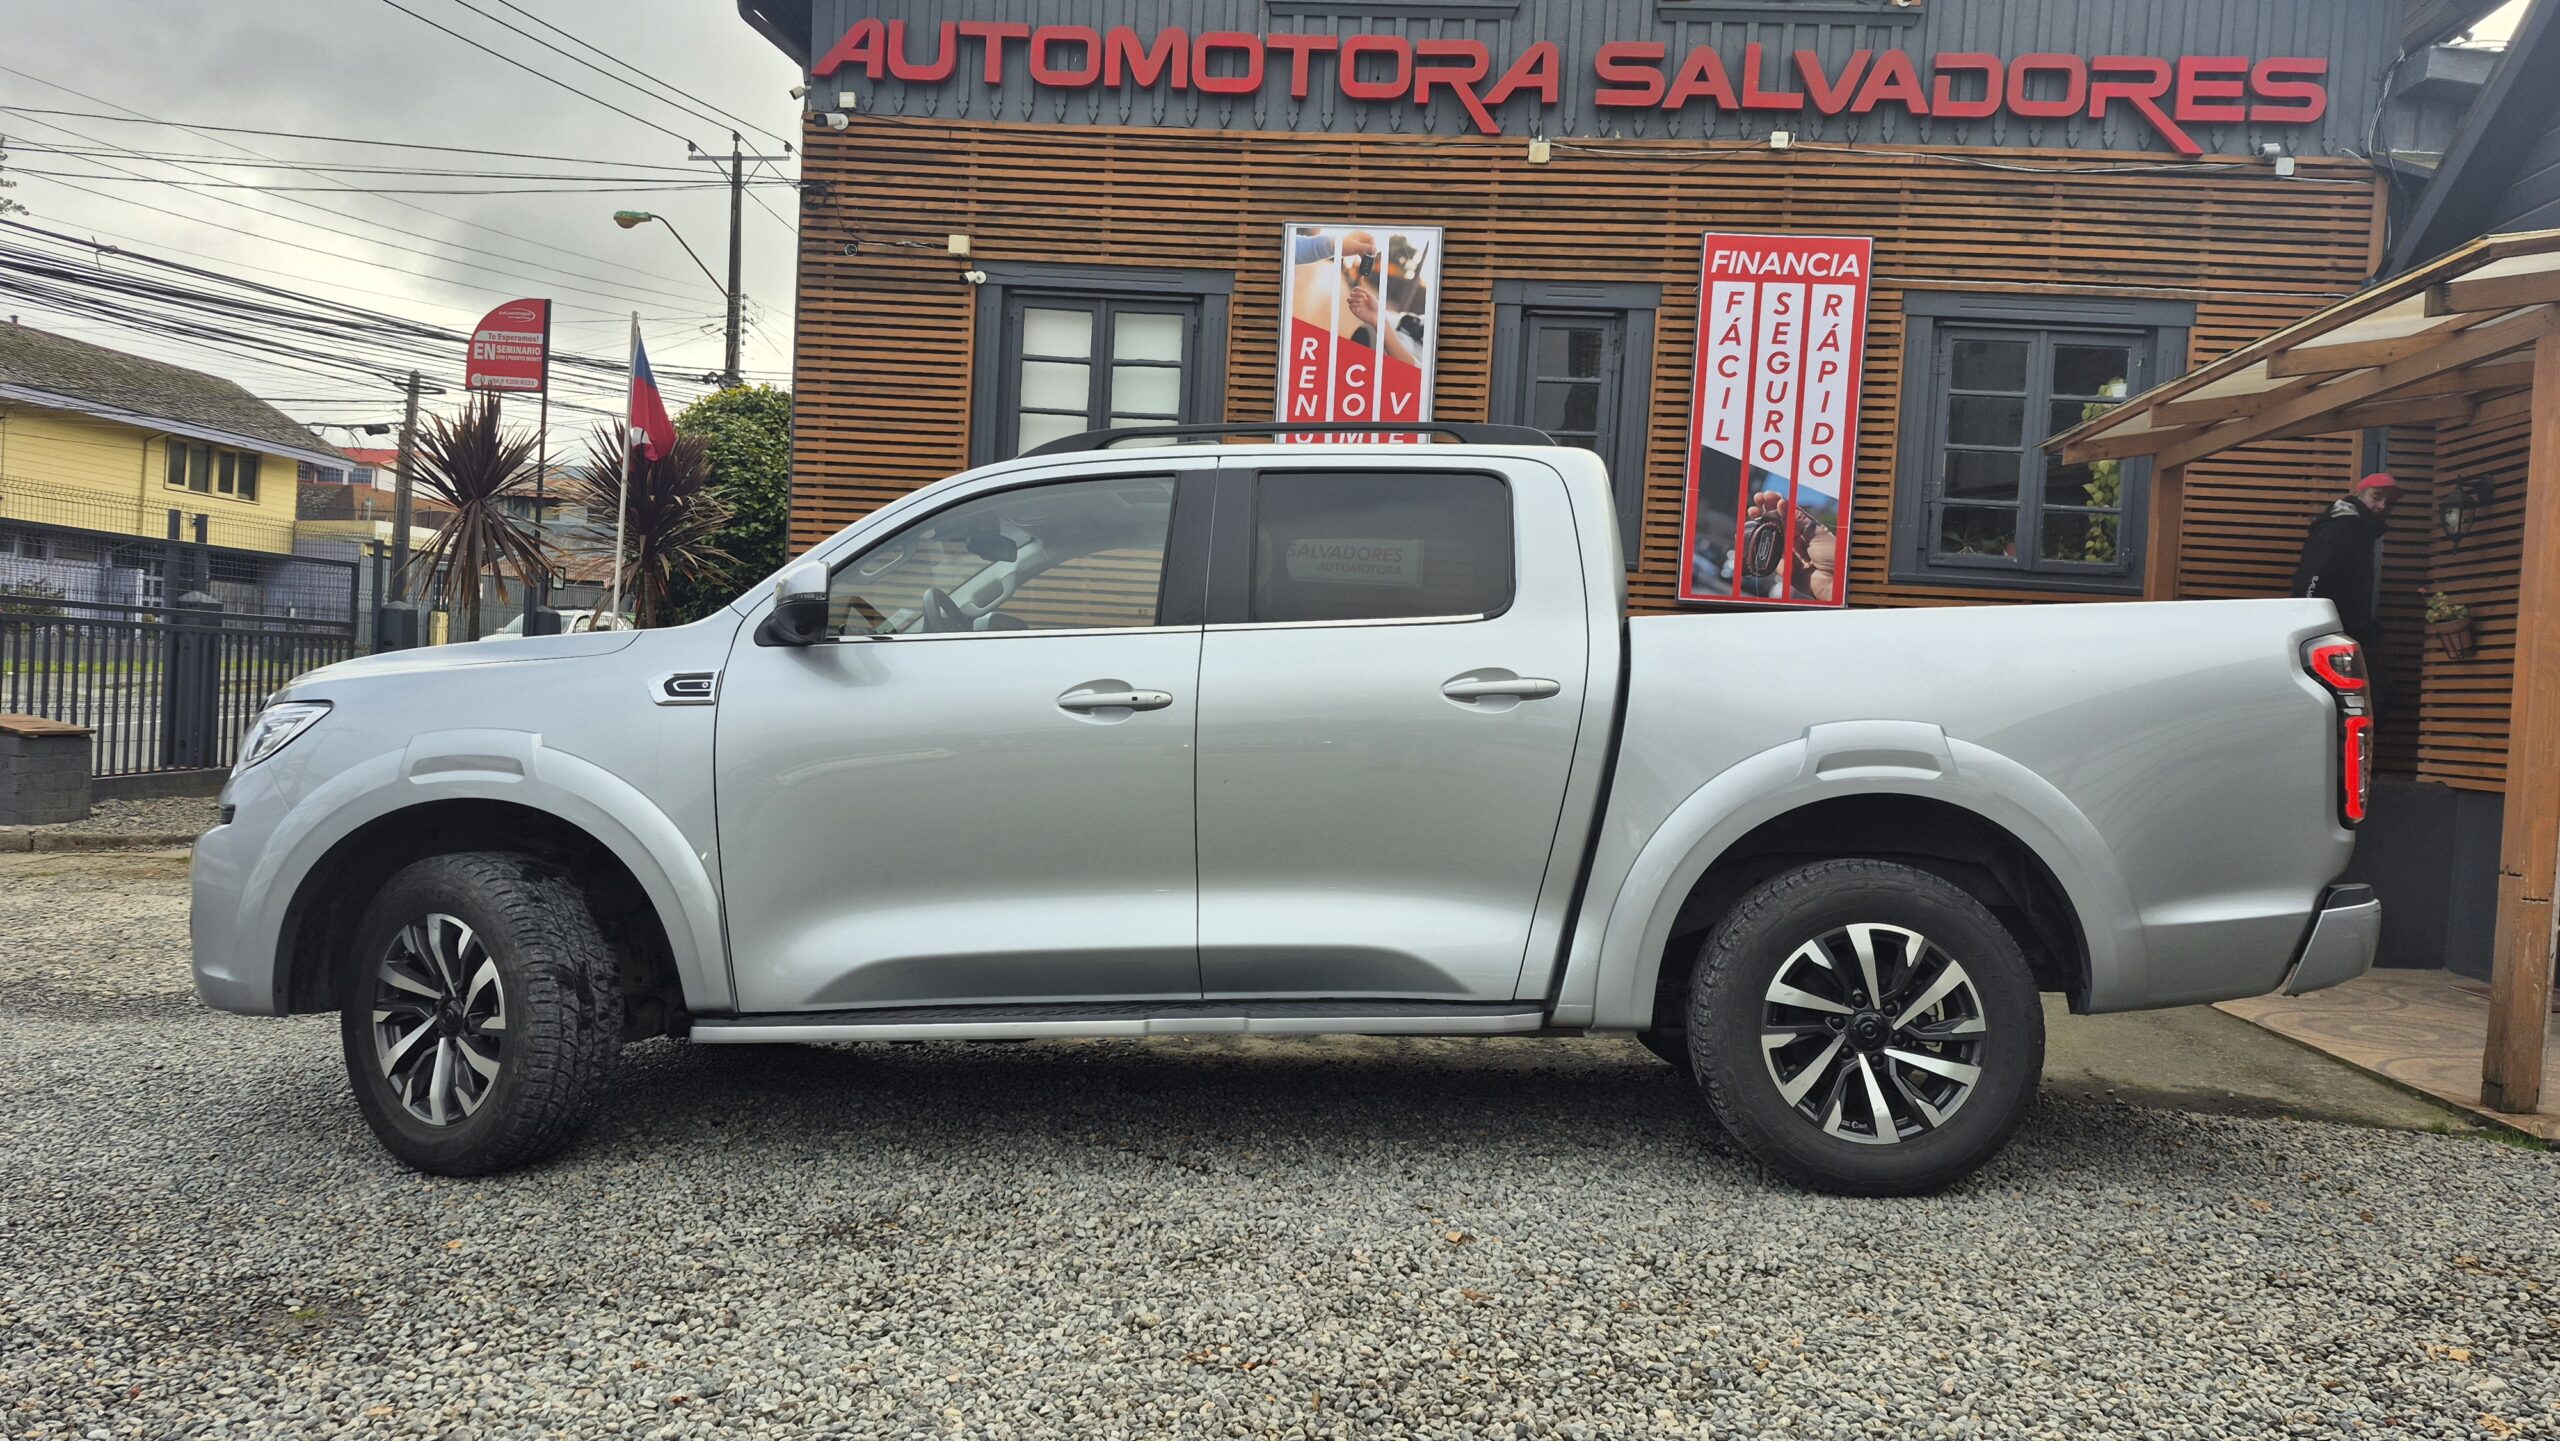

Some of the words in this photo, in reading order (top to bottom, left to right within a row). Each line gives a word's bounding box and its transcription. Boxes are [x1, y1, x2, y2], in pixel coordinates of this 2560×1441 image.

[811, 18, 1560, 134] AUTOMOTORA
[1594, 40, 2328, 156] SALVADORES
[1710, 250, 1860, 278] FINANCIA
[488, 332, 496, 340] Te
[498, 333, 540, 343] Esperamos!
[474, 342, 496, 360] EN
[496, 345, 541, 356] SEMINARIO
[1715, 290, 1745, 442] FÁCIL
[1759, 290, 1793, 463] SEGURO
[1808, 293, 1843, 478] RÁPIDO
[1287, 543, 1405, 563] SALVADORES
[1317, 562, 1402, 576] AUTOMOTORA
